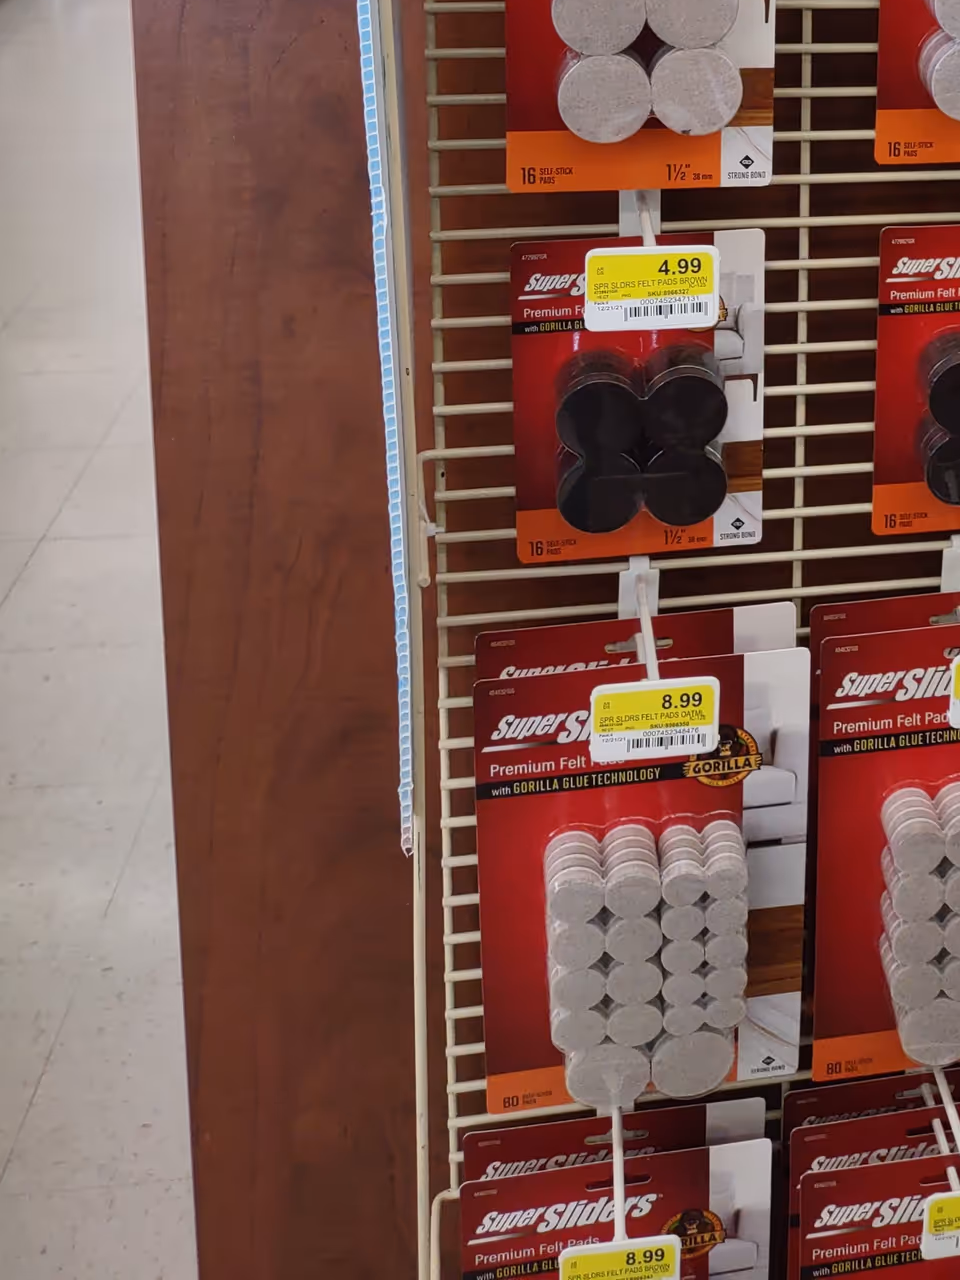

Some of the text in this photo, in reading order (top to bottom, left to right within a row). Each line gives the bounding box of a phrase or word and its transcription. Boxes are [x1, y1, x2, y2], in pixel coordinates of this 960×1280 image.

[658, 258, 701, 275] 4.99
[524, 273, 580, 291] Super
[890, 290, 934, 300] Premium
[938, 288, 956, 298] Felt
[524, 308, 572, 318] Premium
[904, 304, 934, 313] GORILLA
[936, 302, 953, 312] GLUE
[540, 321, 572, 331] GORILLA
[662, 692, 702, 709] 8.99
[833, 714, 921, 734] Premium Felt
[834, 743, 852, 754] with
[854, 736, 896, 751] GORILLA
[899, 733, 924, 747] GLUE
[490, 756, 587, 777] Premium Felt
[692, 758, 752, 775] GORILLA
[492, 768, 660, 796] with GORILLA GLUE TECHNOLOGY
[503, 1096, 518, 1108] 80
[626, 1248, 665, 1266] 8.99
[812, 1238, 896, 1261] Premium Felt
[496, 1260, 538, 1277] GORILLA
[813, 1254, 898, 1277] with GORILLA GLUE
